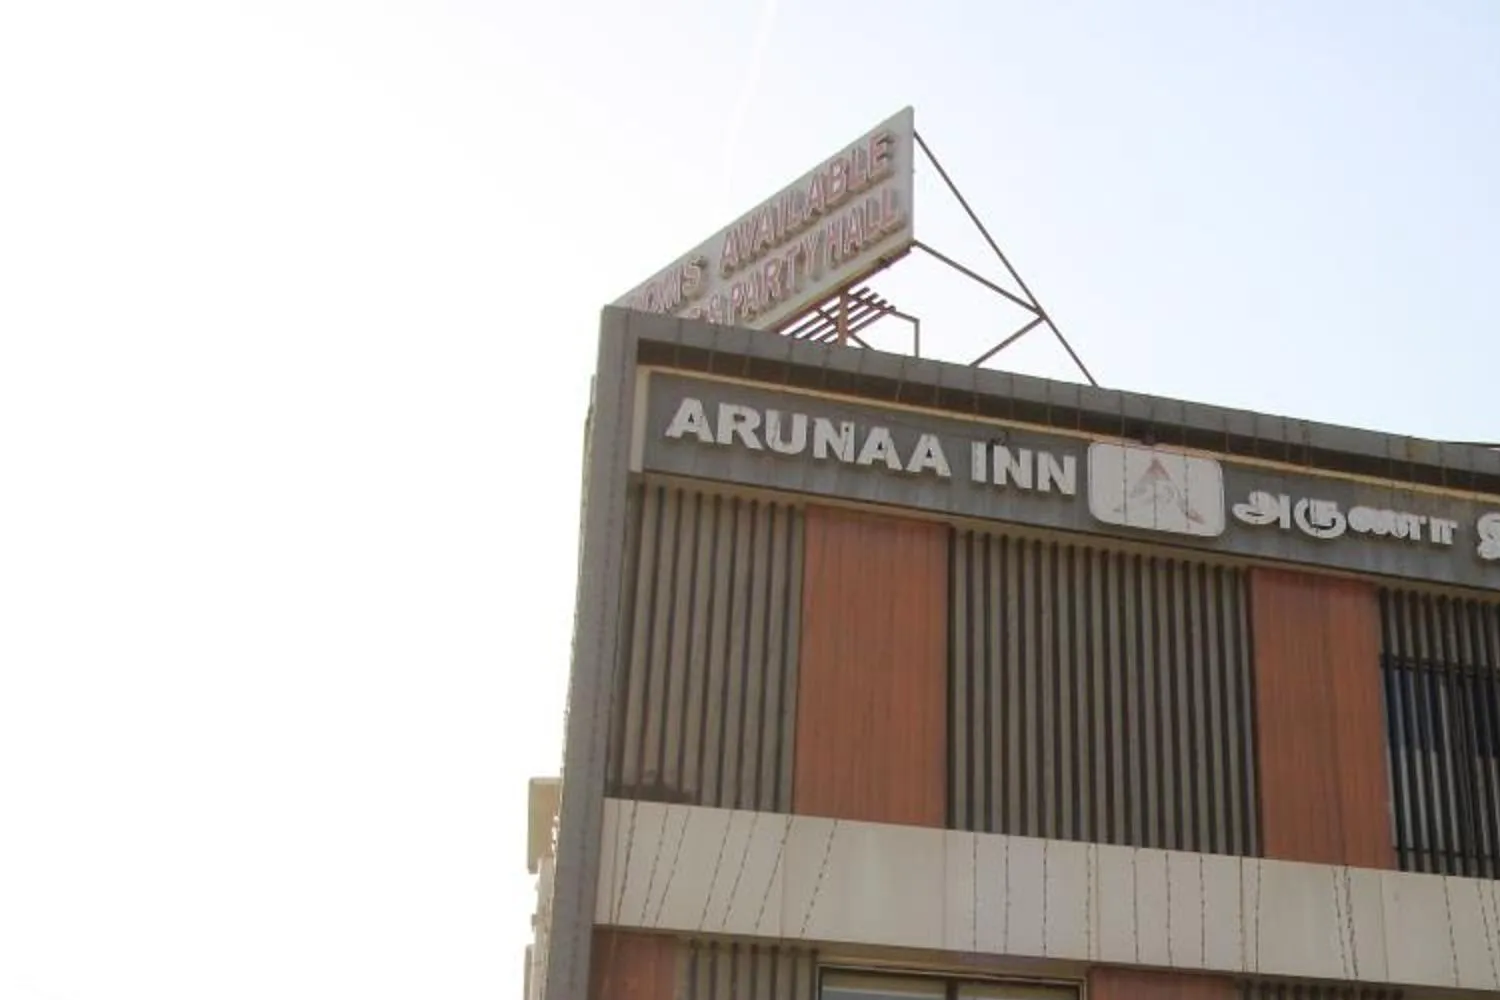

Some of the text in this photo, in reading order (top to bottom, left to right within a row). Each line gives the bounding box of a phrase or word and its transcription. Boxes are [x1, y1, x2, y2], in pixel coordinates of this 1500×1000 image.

[720, 132, 896, 268] AVAILABLE
[825, 190, 903, 264] HALL
[665, 398, 1076, 495] ARUNAA INN
[1232, 491, 1457, 547] அருணா
